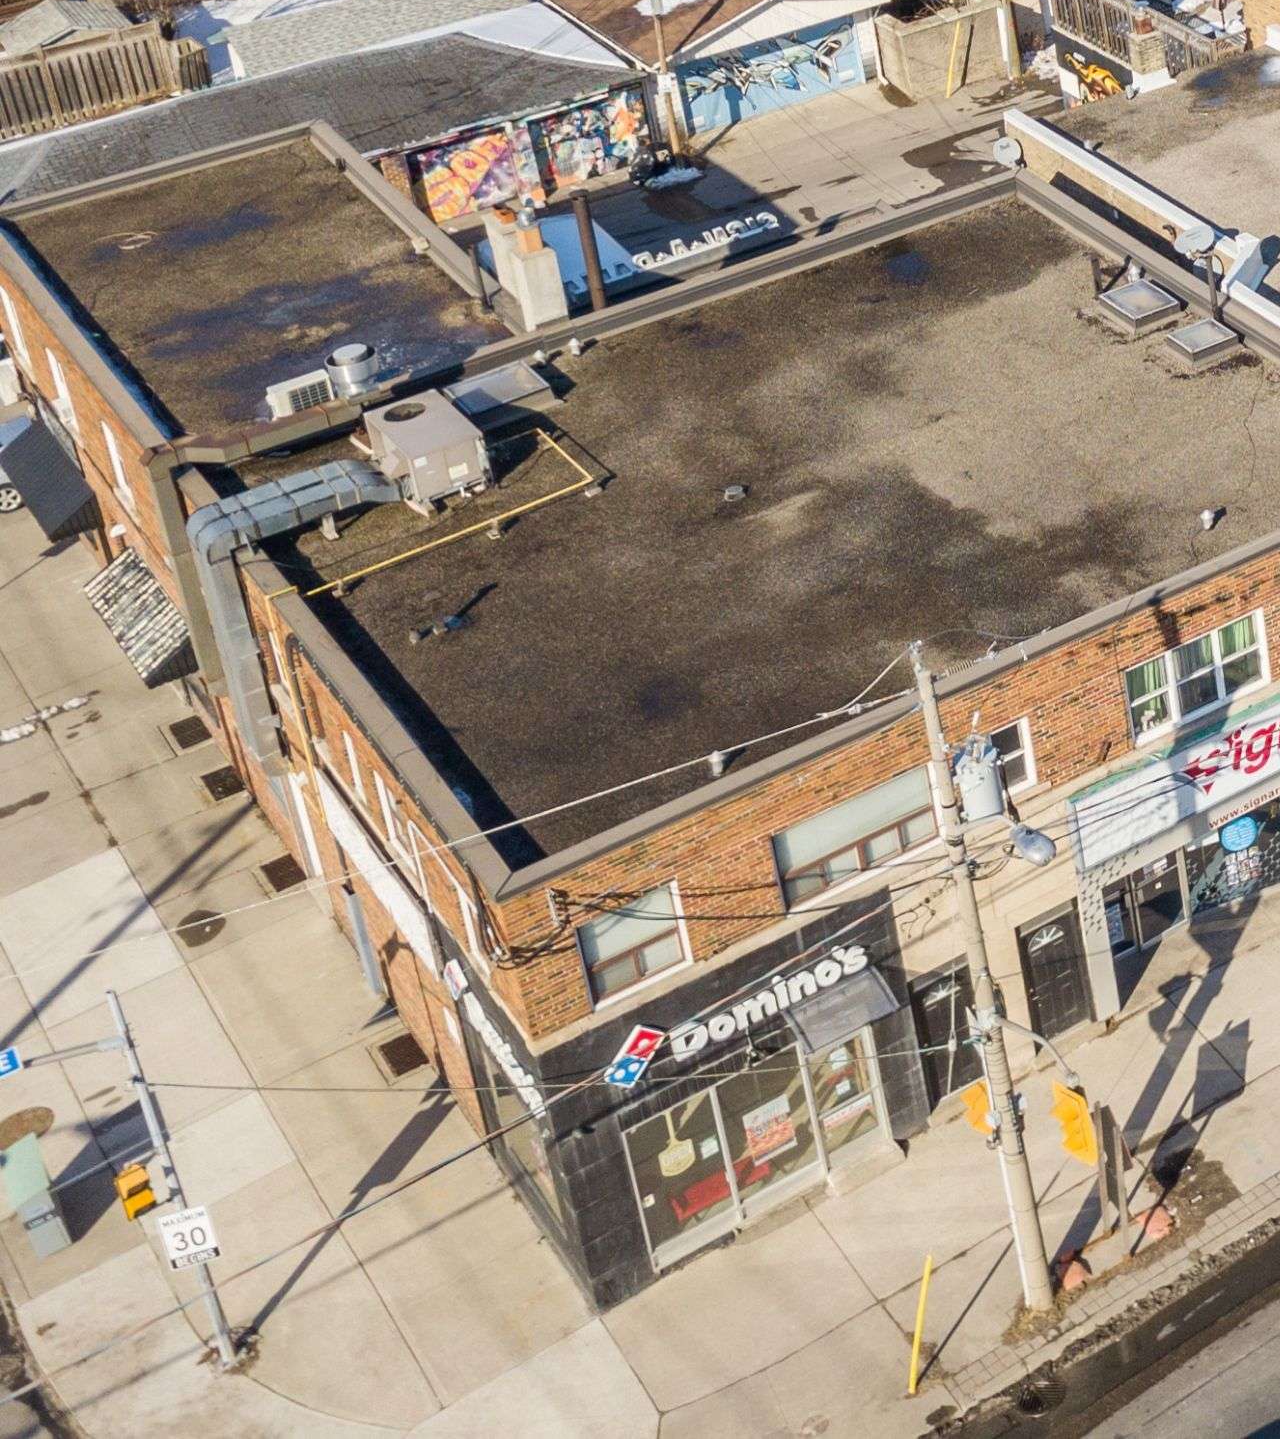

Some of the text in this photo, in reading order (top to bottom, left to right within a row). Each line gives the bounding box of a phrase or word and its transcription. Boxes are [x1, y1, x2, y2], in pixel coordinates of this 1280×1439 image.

[669, 945, 869, 1062] Domino's
[161, 1210, 205, 1227] MAXIMUM
[172, 1226, 207, 1251] 30
